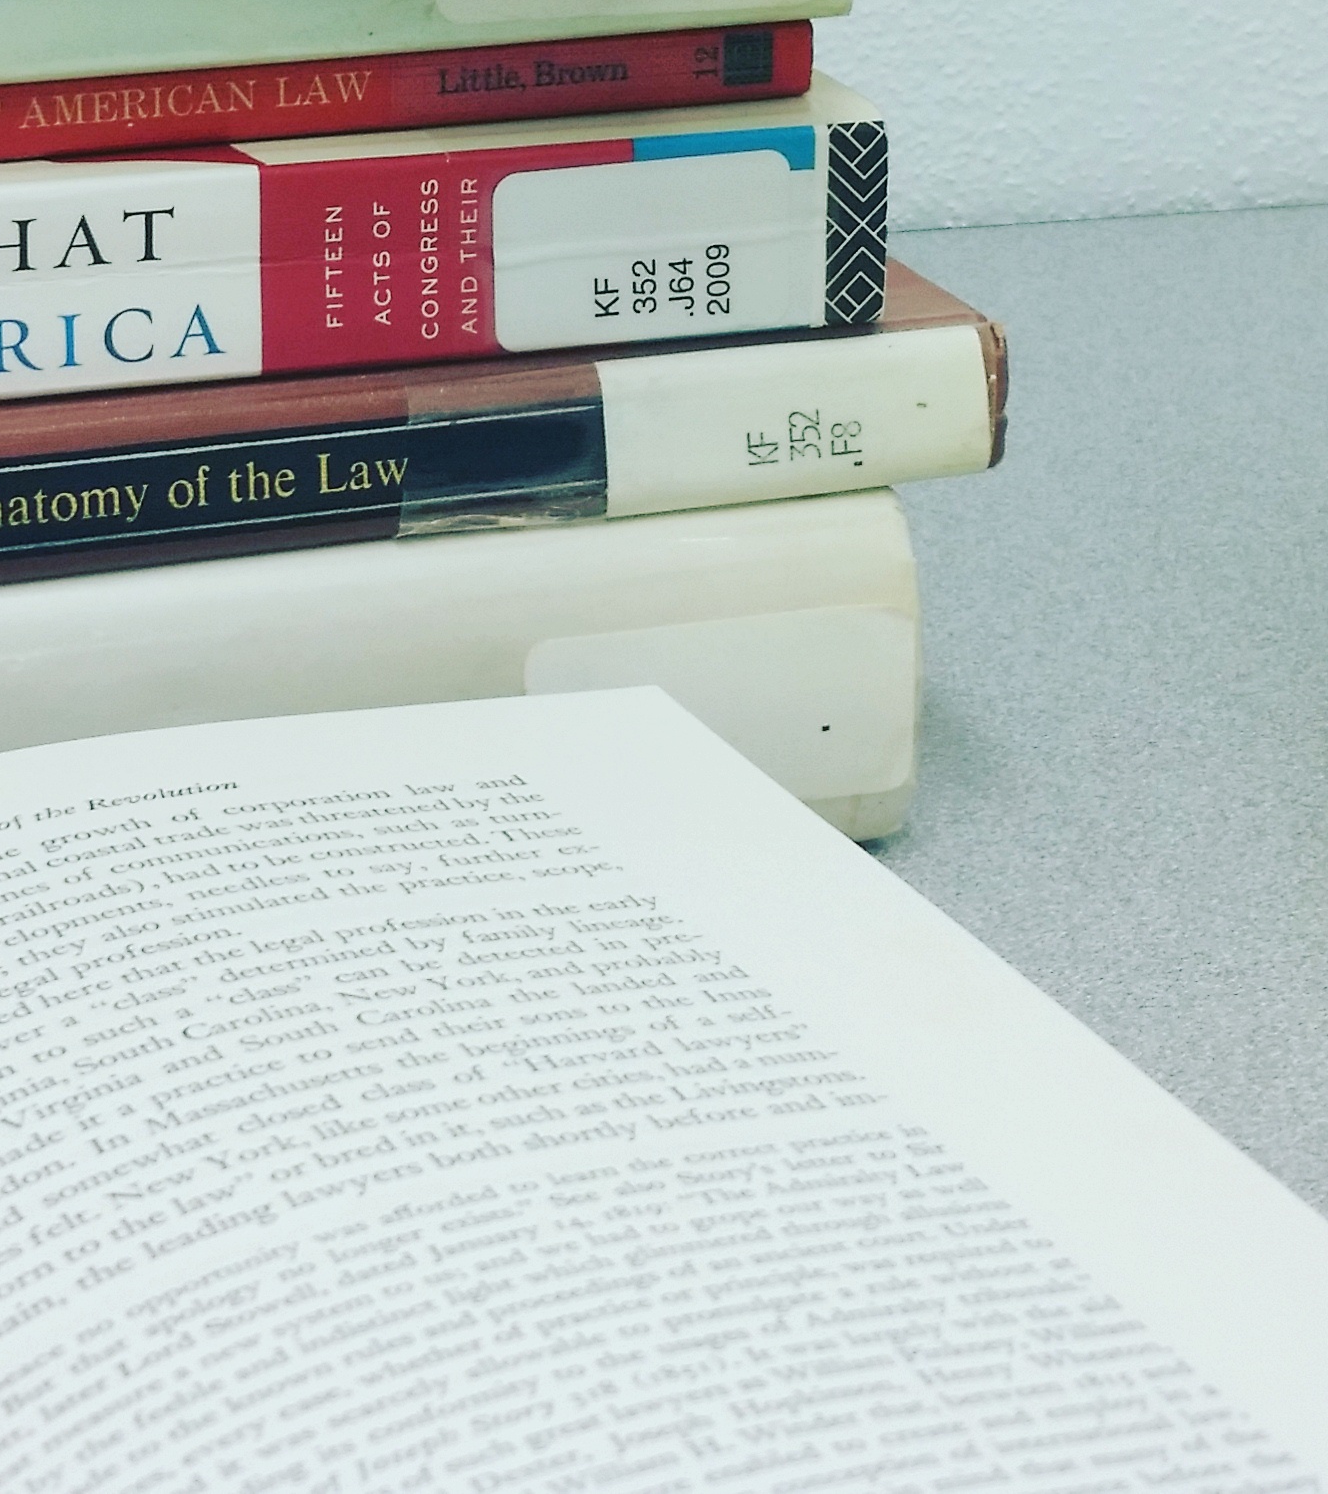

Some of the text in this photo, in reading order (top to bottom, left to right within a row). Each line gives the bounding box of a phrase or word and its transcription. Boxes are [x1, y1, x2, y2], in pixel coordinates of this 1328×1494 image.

[437, 57, 630, 97] Little, Brown
[692, 46, 719, 79] 12
[21, 79, 257, 129] AMERICAN
[275, 69, 373, 110] LAW
[325, 204, 344, 329] FIFTEEN
[373, 199, 392, 327] ACTS OF
[420, 177, 440, 340] CONGRESS
[461, 177, 478, 335] AND THEIR
[632, 257, 657, 314] 352
[705, 243, 731, 315] 2009
[594, 275, 620, 319] KF
[748, 430, 780, 468] KF
[789, 408, 821, 462] 352
[167, 464, 210, 508] of
[228, 459, 297, 503] the
[318, 451, 409, 495] Law
[34, 802, 77, 822] the
[86, 781, 238, 811] Revolution
[39, 816, 152, 854] growth
[171, 808, 200, 825] of
[222, 787, 391, 817] corporation
[405, 781, 456, 797] law
[474, 774, 528, 791] and
[45, 835, 149, 870] coastal
[152, 824, 231, 847] trade
[236, 814, 294, 832] was
[297, 797, 451, 828] threatened
[453, 795, 492, 813] by
[497, 789, 545, 805] the
[62, 866, 95, 884] of
[109, 826, 365, 874] communications,
[372, 818, 440, 836] such
[450, 816, 480, 828] as
[487, 809, 564, 826] turn-
[163, 864, 220, 885] had
[227, 859, 259, 874] to
[266, 850, 304, 867] be
[309, 831, 491, 861] constructed.
[496, 822, 583, 843] These
[187, 871, 312, 901] needless
[322, 865, 355, 878] to
[368, 861, 429, 876] say,
[437, 846, 542, 867] further
[557, 843, 601, 856] ex-
[15, 941, 86, 971] they
[101, 919, 160, 942] also
[170, 887, 330, 927] stimulated
[337, 880, 388, 897] the
[398, 868, 526, 895] practice,
[532, 859, 623, 877] scope,
